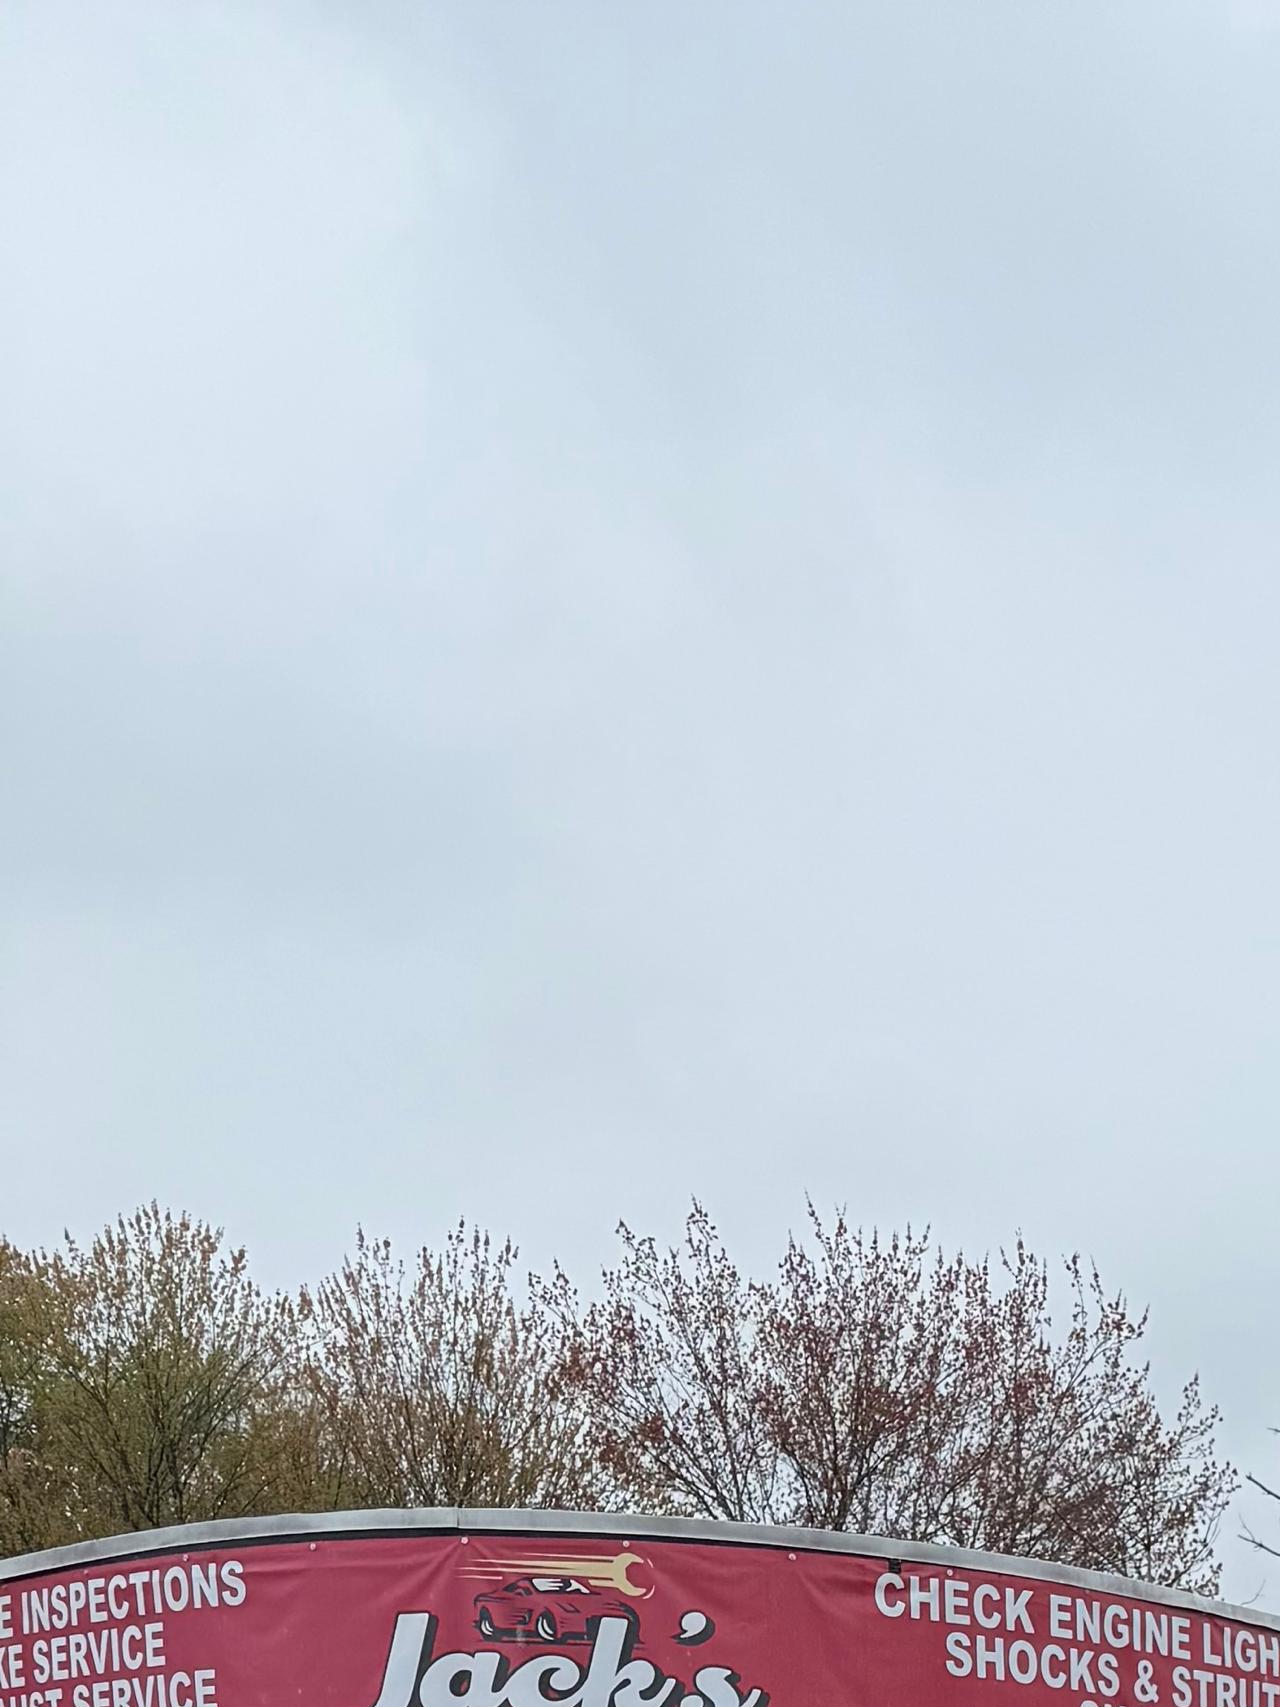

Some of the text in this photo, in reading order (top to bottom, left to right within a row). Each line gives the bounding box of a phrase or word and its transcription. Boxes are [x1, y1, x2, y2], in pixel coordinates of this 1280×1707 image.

[21, 1560, 247, 1635] INSPECTIONS
[874, 1572, 1034, 1634] CHECK
[1049, 1593, 1192, 1660] ENGINE
[33, 1622, 166, 1684] SERVICE
[945, 1631, 1120, 1698] SHOCKS
[1133, 1659, 1159, 1704] &
